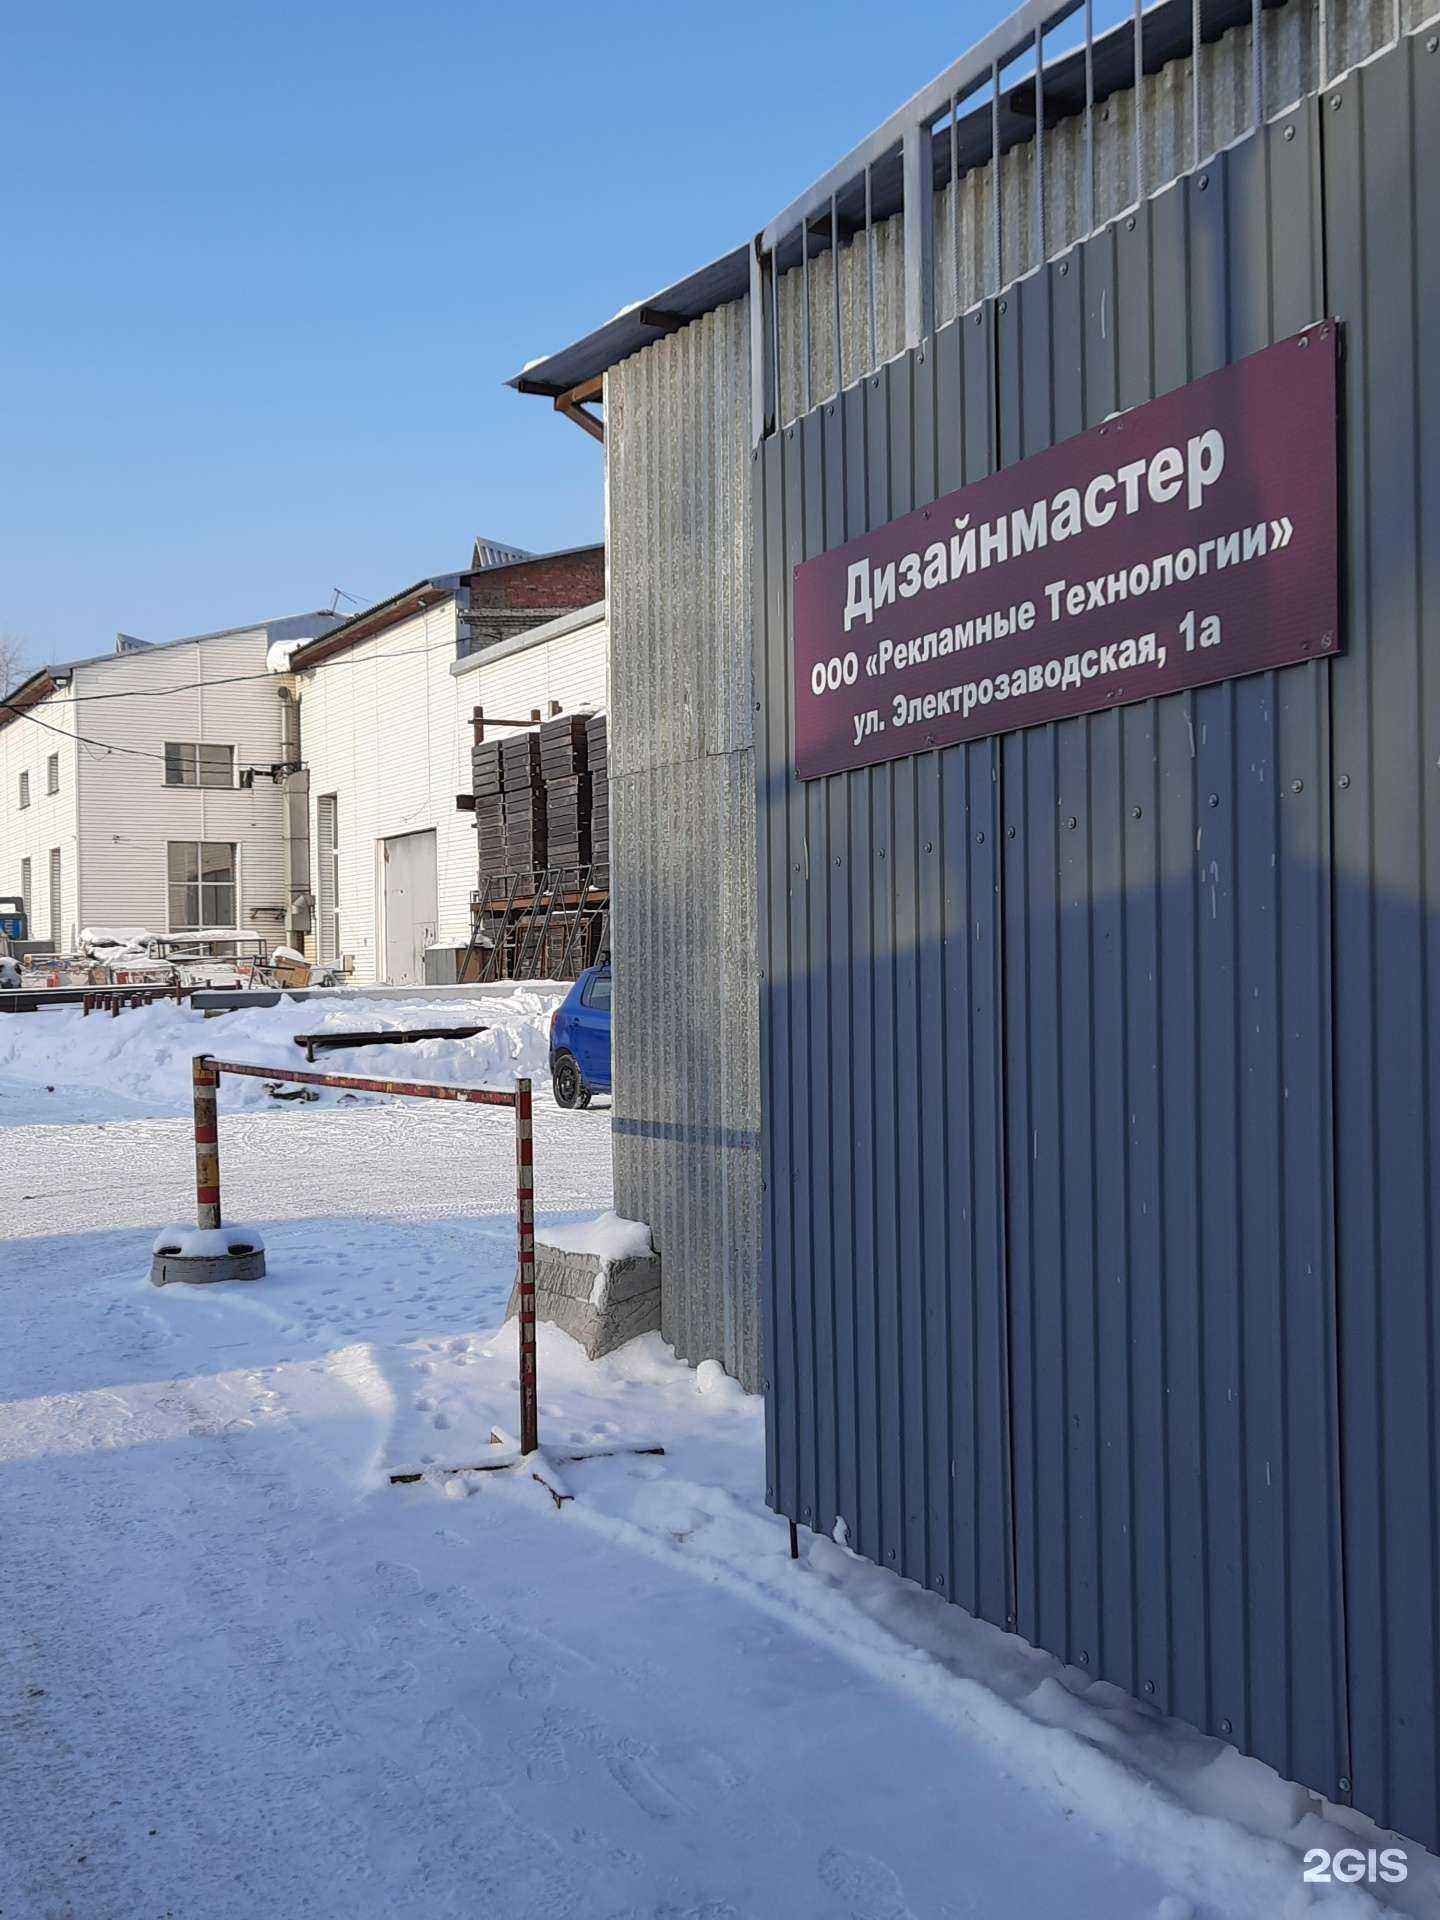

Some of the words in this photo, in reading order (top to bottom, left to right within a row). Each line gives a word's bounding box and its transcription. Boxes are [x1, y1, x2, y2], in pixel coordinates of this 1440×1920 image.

[811, 652, 858, 696] ООО
[865, 600, 1036, 680] «Рекламные
[1045, 515, 1294, 623] Технологии»
[843, 428, 1226, 632] Дизайнмастер
[852, 706, 885, 746] ул.
[892, 630, 1167, 728] Электрозаводская,
[1178, 610, 1222, 654] 1а
